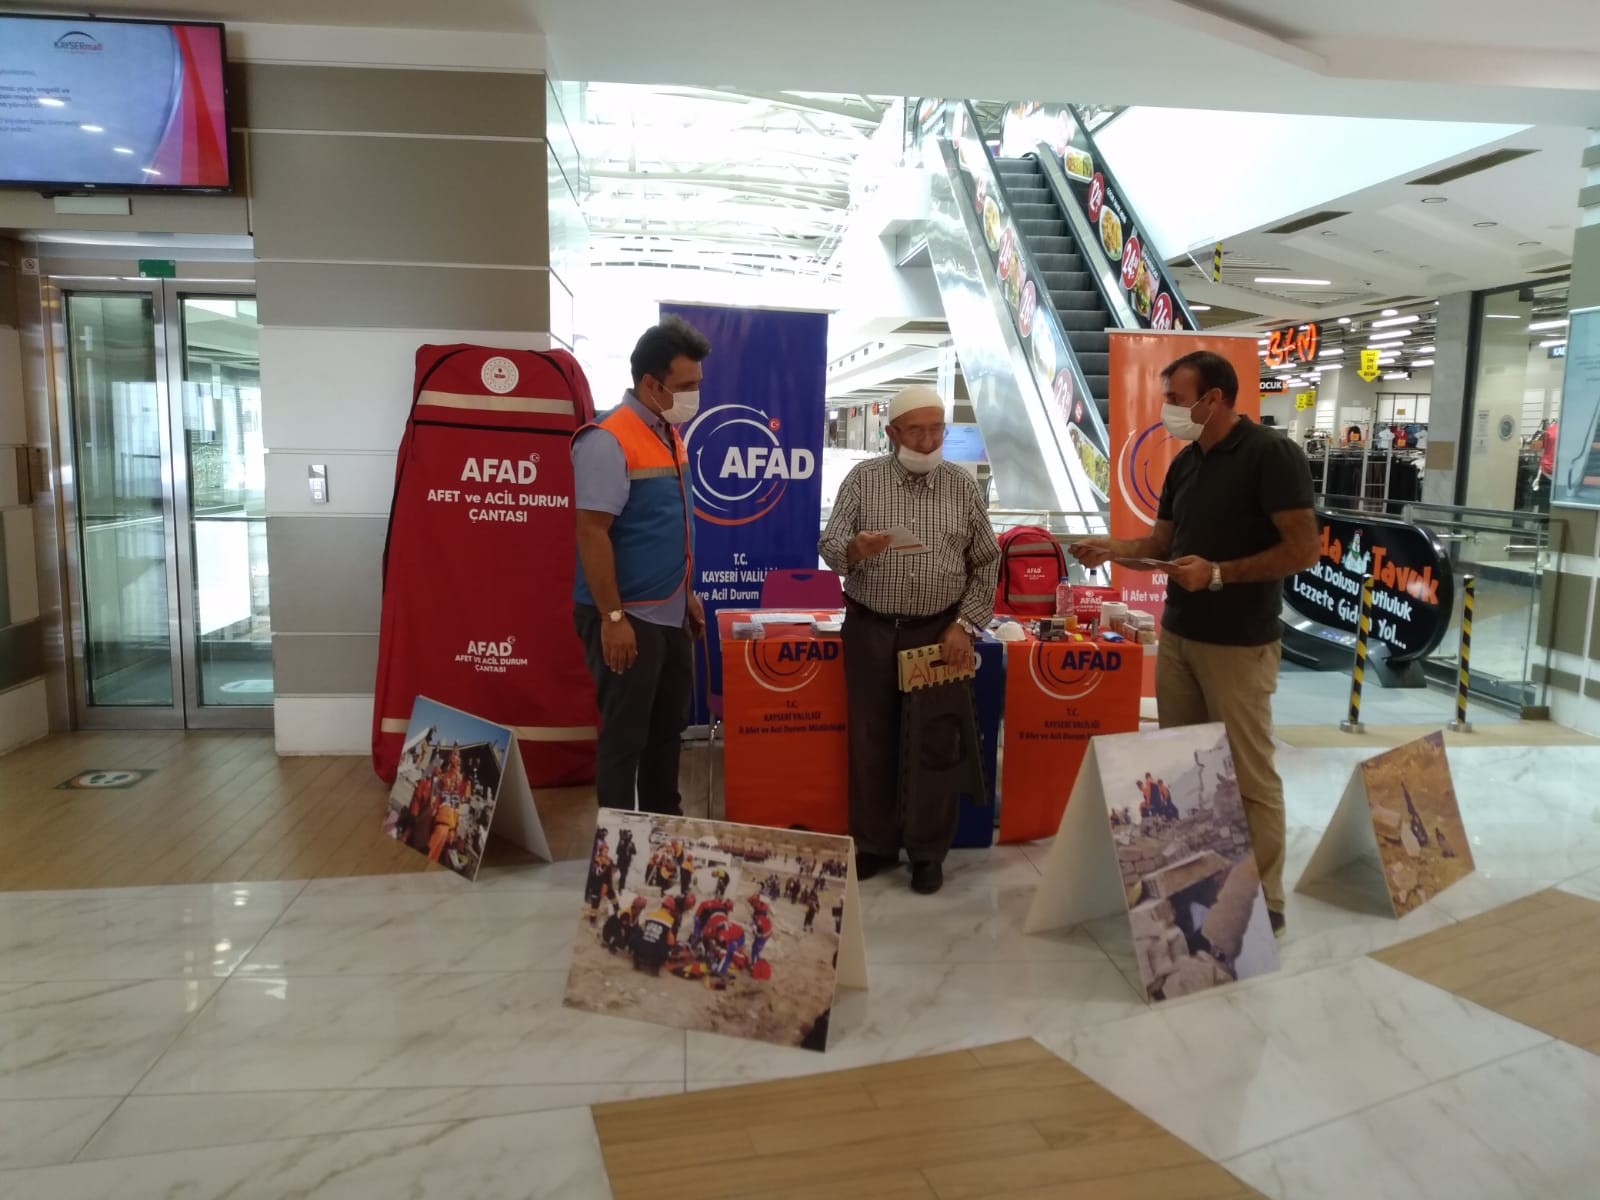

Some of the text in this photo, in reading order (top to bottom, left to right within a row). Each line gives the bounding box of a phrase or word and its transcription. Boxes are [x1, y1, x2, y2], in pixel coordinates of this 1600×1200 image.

[1260, 381, 1282, 390] OCUK
[719, 446, 815, 479] AFAD
[461, 457, 537, 485] AFAD
[427, 489, 569, 508] AFET ve ACİL DURUM
[469, 509, 528, 523] ÇANTASI
[733, 553, 748, 565] T.C.
[702, 568, 738, 583] KAYSERİ
[1152, 573, 1169, 585] KAY
[1372, 545, 1439, 605] Tavuk
[711, 587, 728, 600] Acil
[730, 588, 759, 601] Durum
[1130, 590, 1148, 602] Afet
[1149, 593, 1160, 602] ve
[1325, 566, 1360, 596] Dolusu
[1371, 590, 1413, 622] utluluk
[1293, 574, 1335, 612] Lezzete
[1338, 598, 1372, 632] Gidn
[467, 640, 512, 656] AFAD
[778, 641, 839, 662] AFAD
[455, 654, 472, 663] AFET
[500, 658, 528, 666] DURUM
[1061, 650, 1122, 671] AFAD
[475, 664, 507, 673] ÇANTASI
